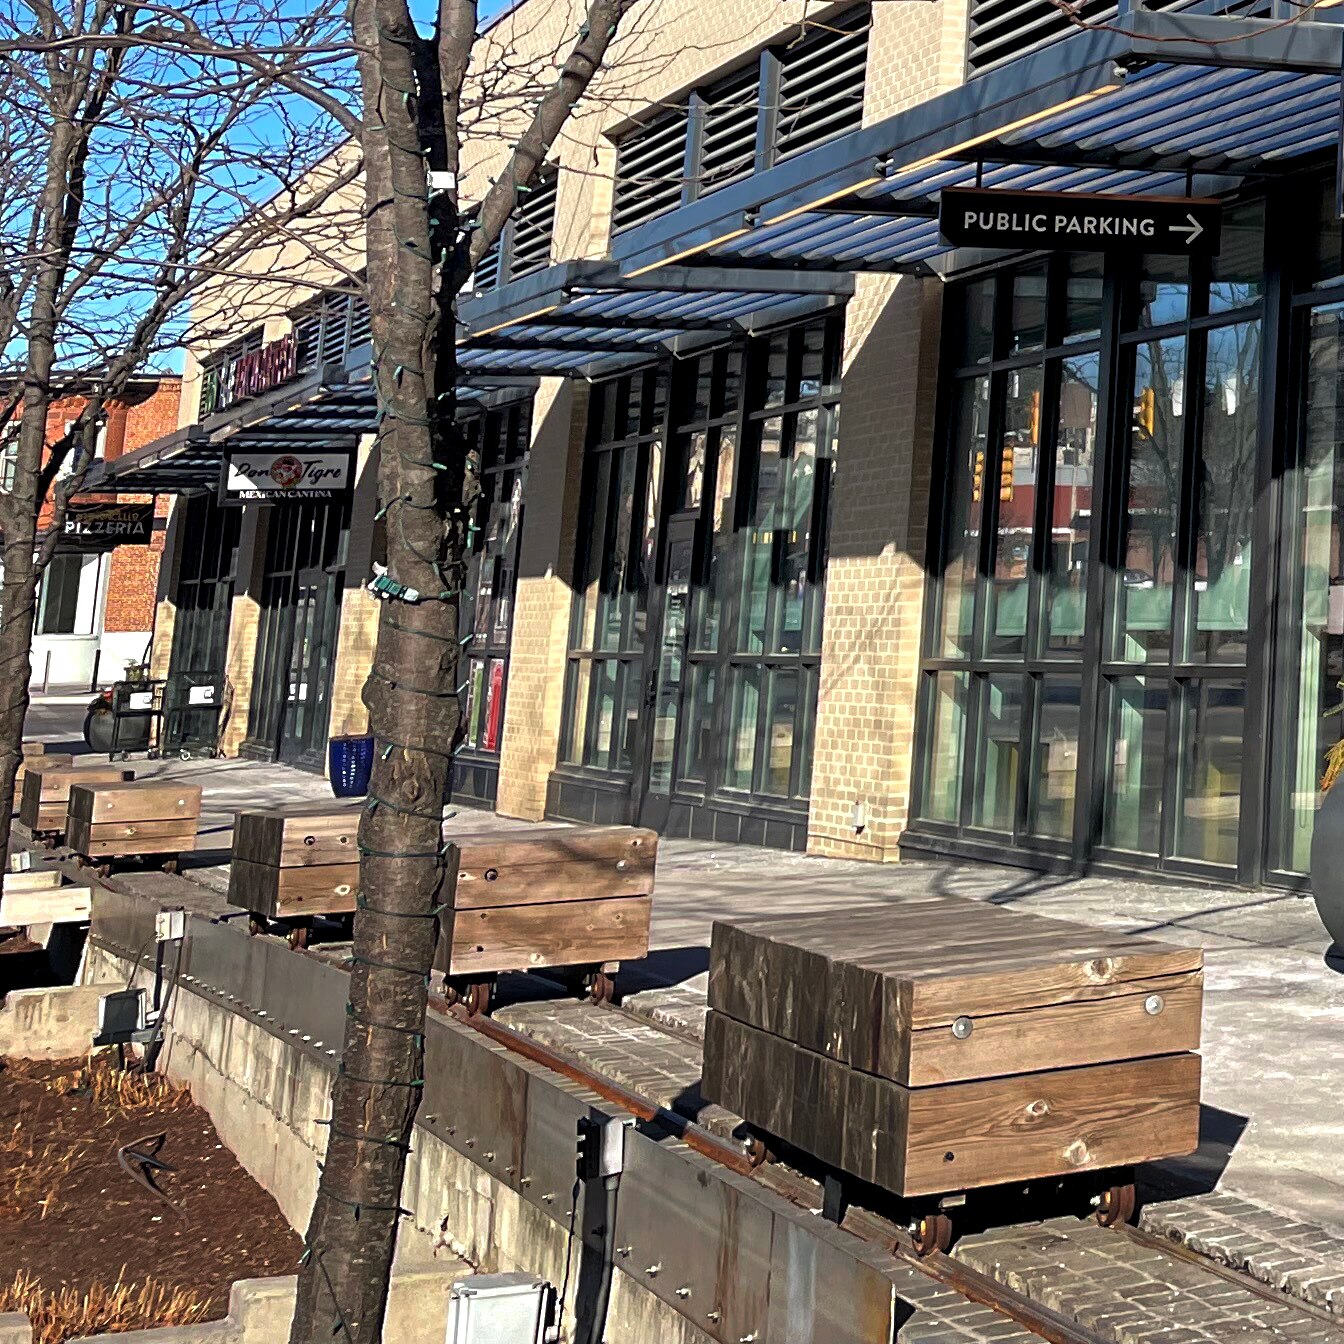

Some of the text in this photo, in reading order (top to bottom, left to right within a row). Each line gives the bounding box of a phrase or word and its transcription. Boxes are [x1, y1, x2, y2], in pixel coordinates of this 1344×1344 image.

[964, 211, 1155, 236] PUBLIC PARKING
[233, 459, 342, 485] Don Tigre
[238, 489, 332, 499] MEXICAN CANTINA
[64, 520, 145, 534] PIZZERIA
